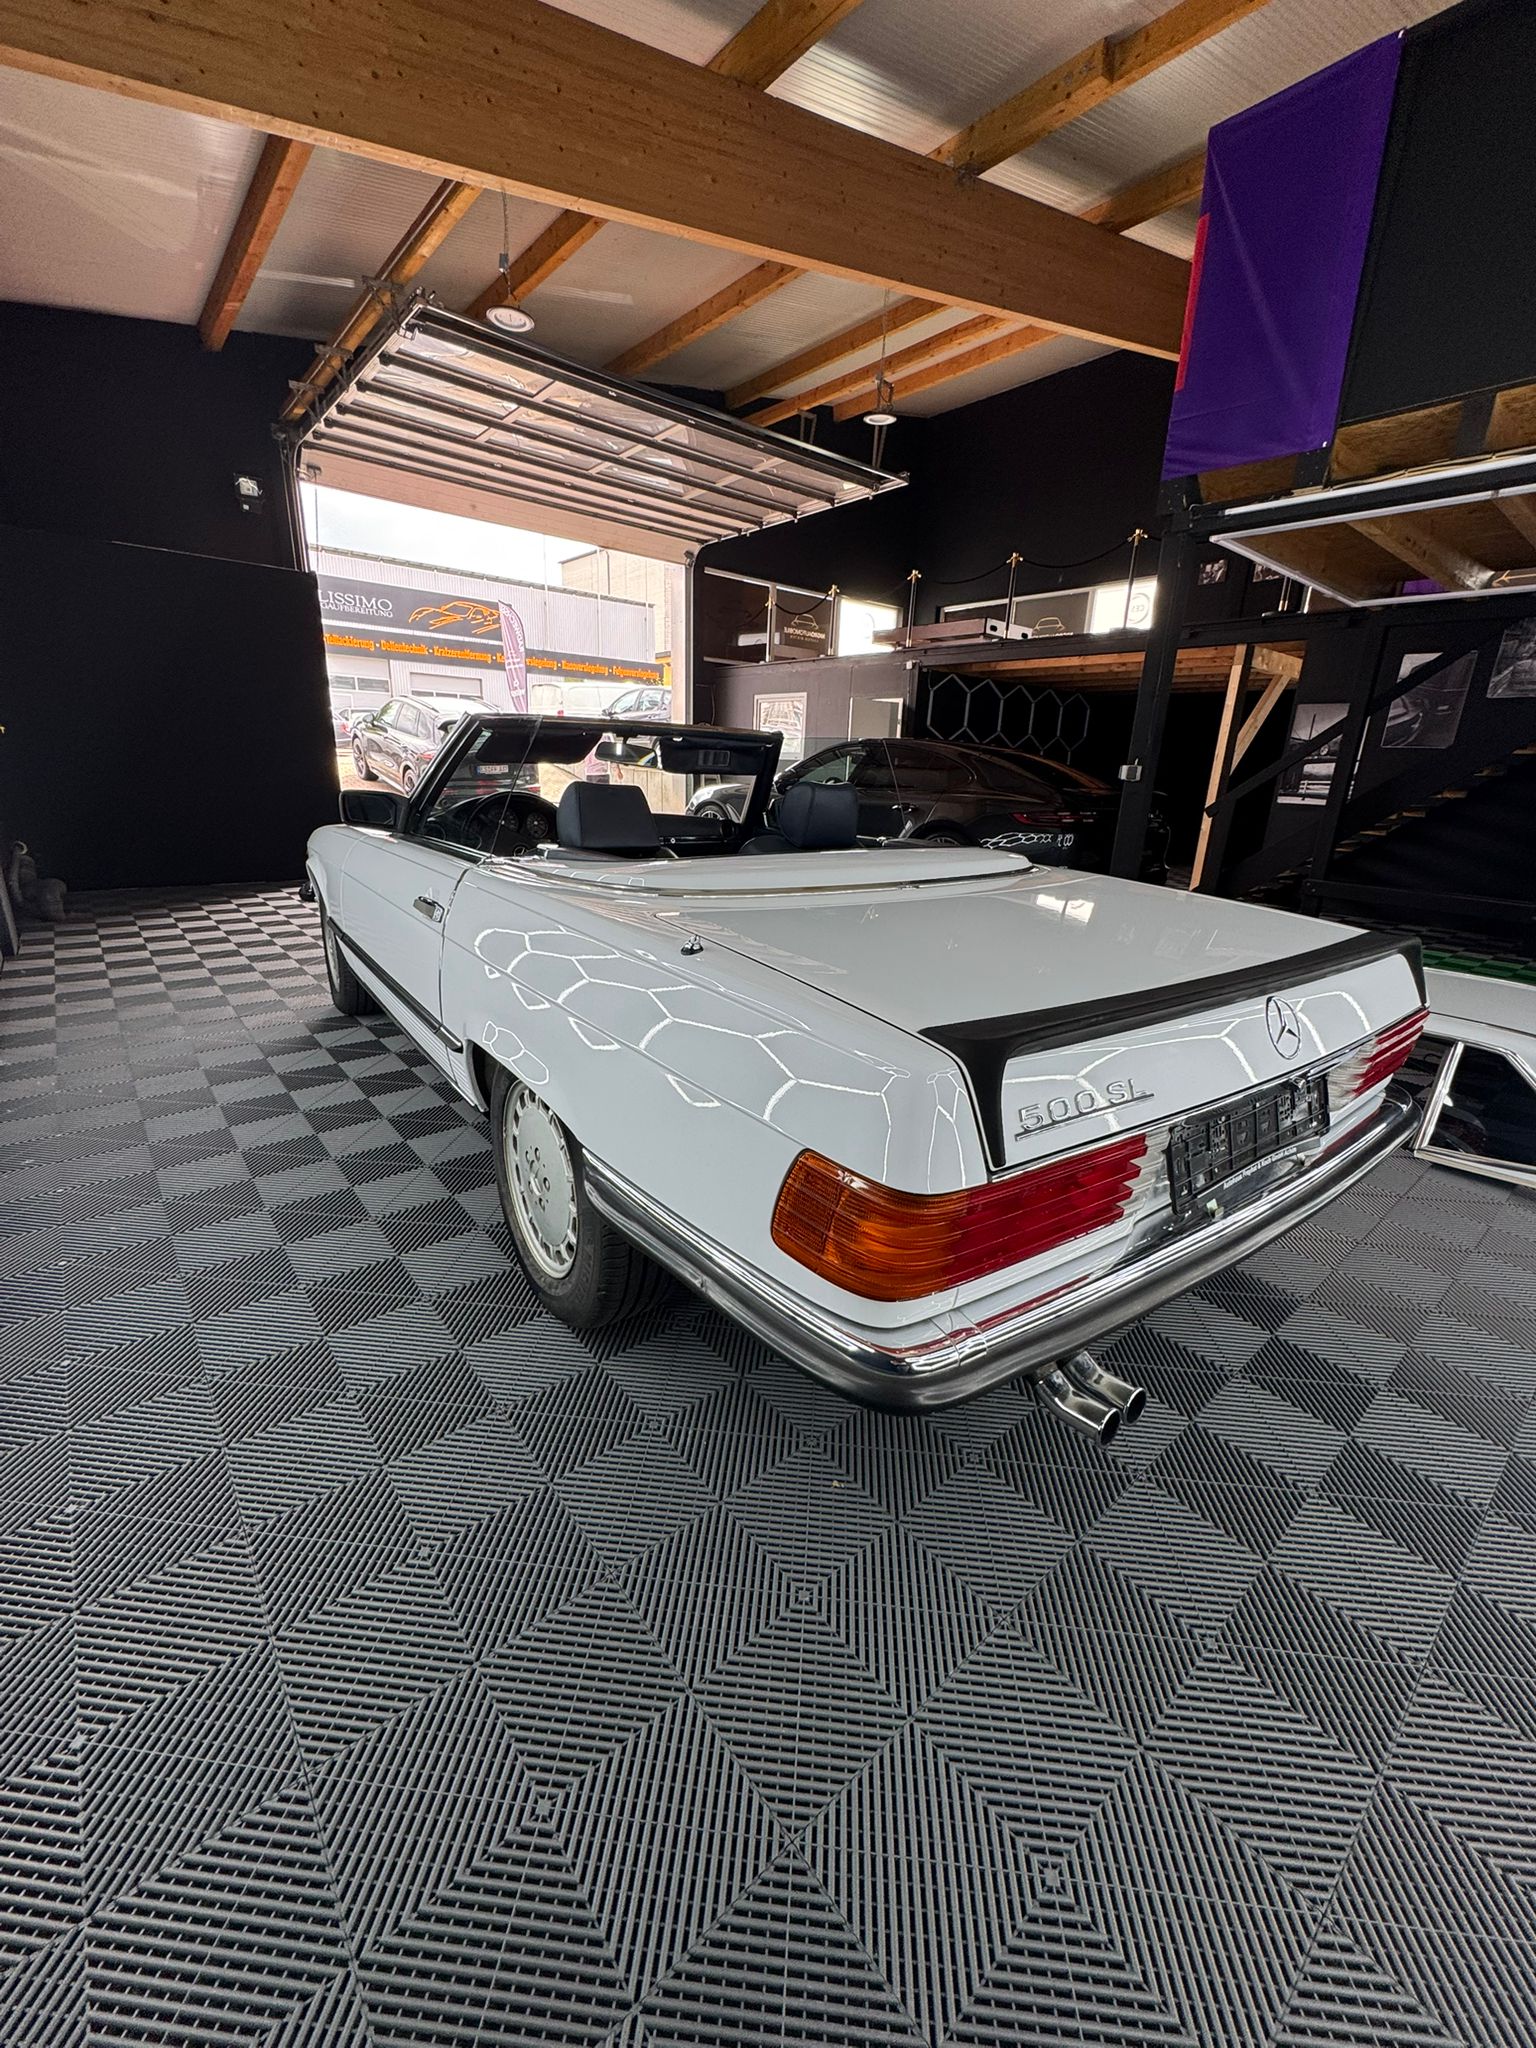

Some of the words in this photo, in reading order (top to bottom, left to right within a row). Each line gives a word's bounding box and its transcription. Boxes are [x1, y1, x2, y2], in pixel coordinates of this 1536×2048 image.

[318, 589, 392, 611] LISSIMO
[1018, 1089, 1098, 1131] 500
[1106, 1078, 1148, 1105] SL
[1223, 1174, 1243, 1190] Autohaus
